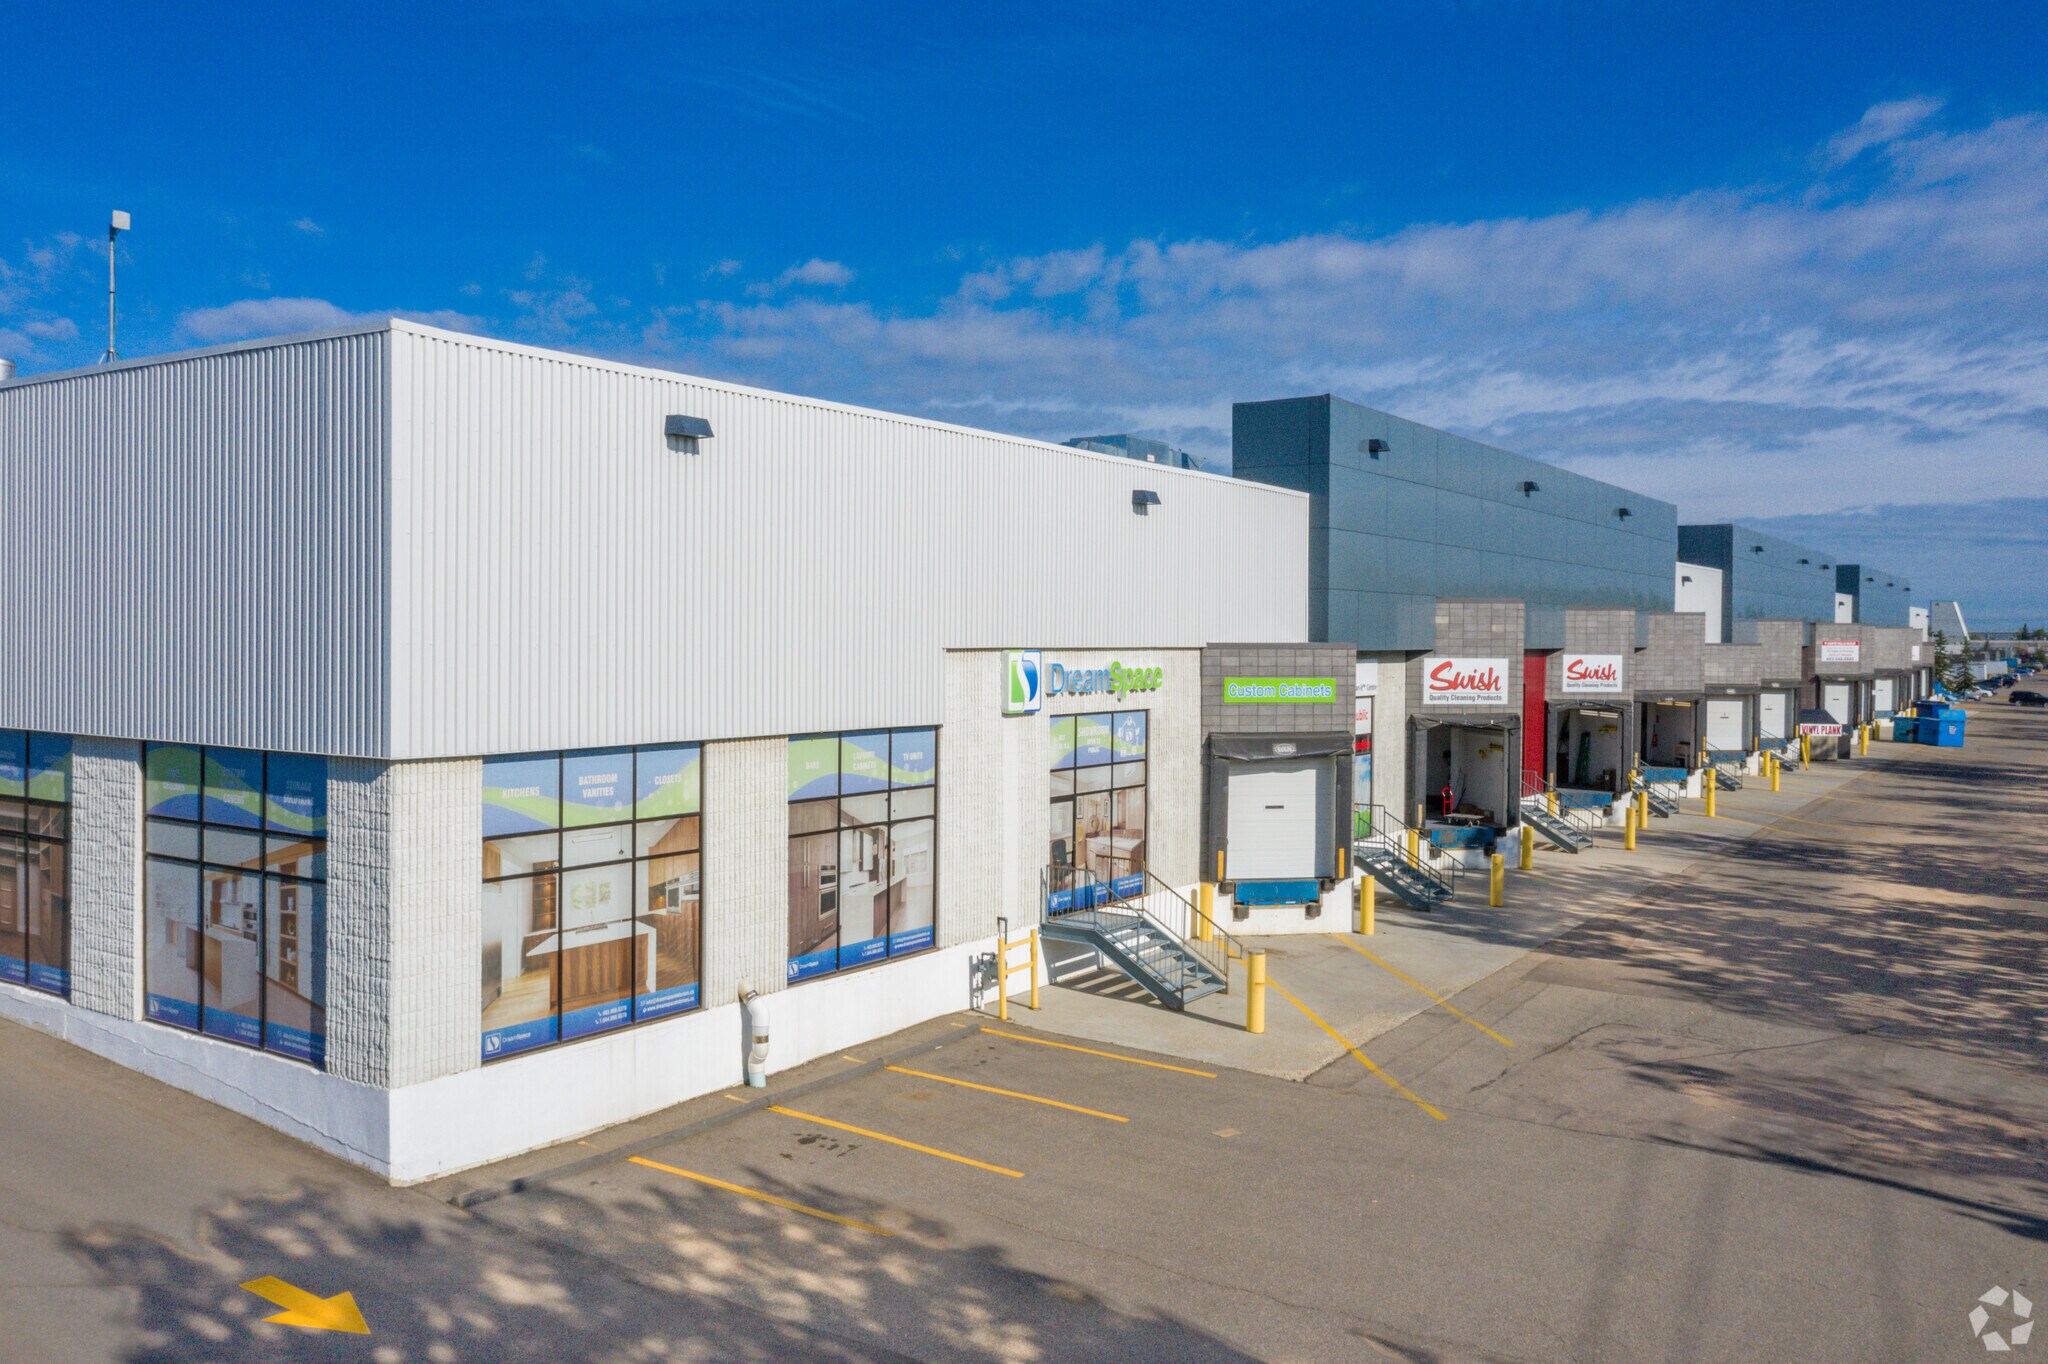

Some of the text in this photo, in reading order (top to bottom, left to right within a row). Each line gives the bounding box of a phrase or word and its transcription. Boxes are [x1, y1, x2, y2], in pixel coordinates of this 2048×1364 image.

[1429, 661, 1502, 691] Swish
[1567, 659, 1617, 681] Swish
[1049, 661, 1163, 698] DreamSpace
[1228, 683, 1332, 698] Custom Cabinets
[1451, 694, 1476, 702] Cleaning
[1078, 725, 1110, 737] SHOWROOM
[1802, 725, 1841, 735] VINYL PLANK
[903, 752, 923, 761] TV UNITS
[853, 761, 876, 771] CABINETS
[578, 773, 618, 786] BATHROOM
[654, 773, 682, 785] CLOSETS
[502, 786, 540, 799] KITCHENS
[582, 786, 614, 798] VANITIES
